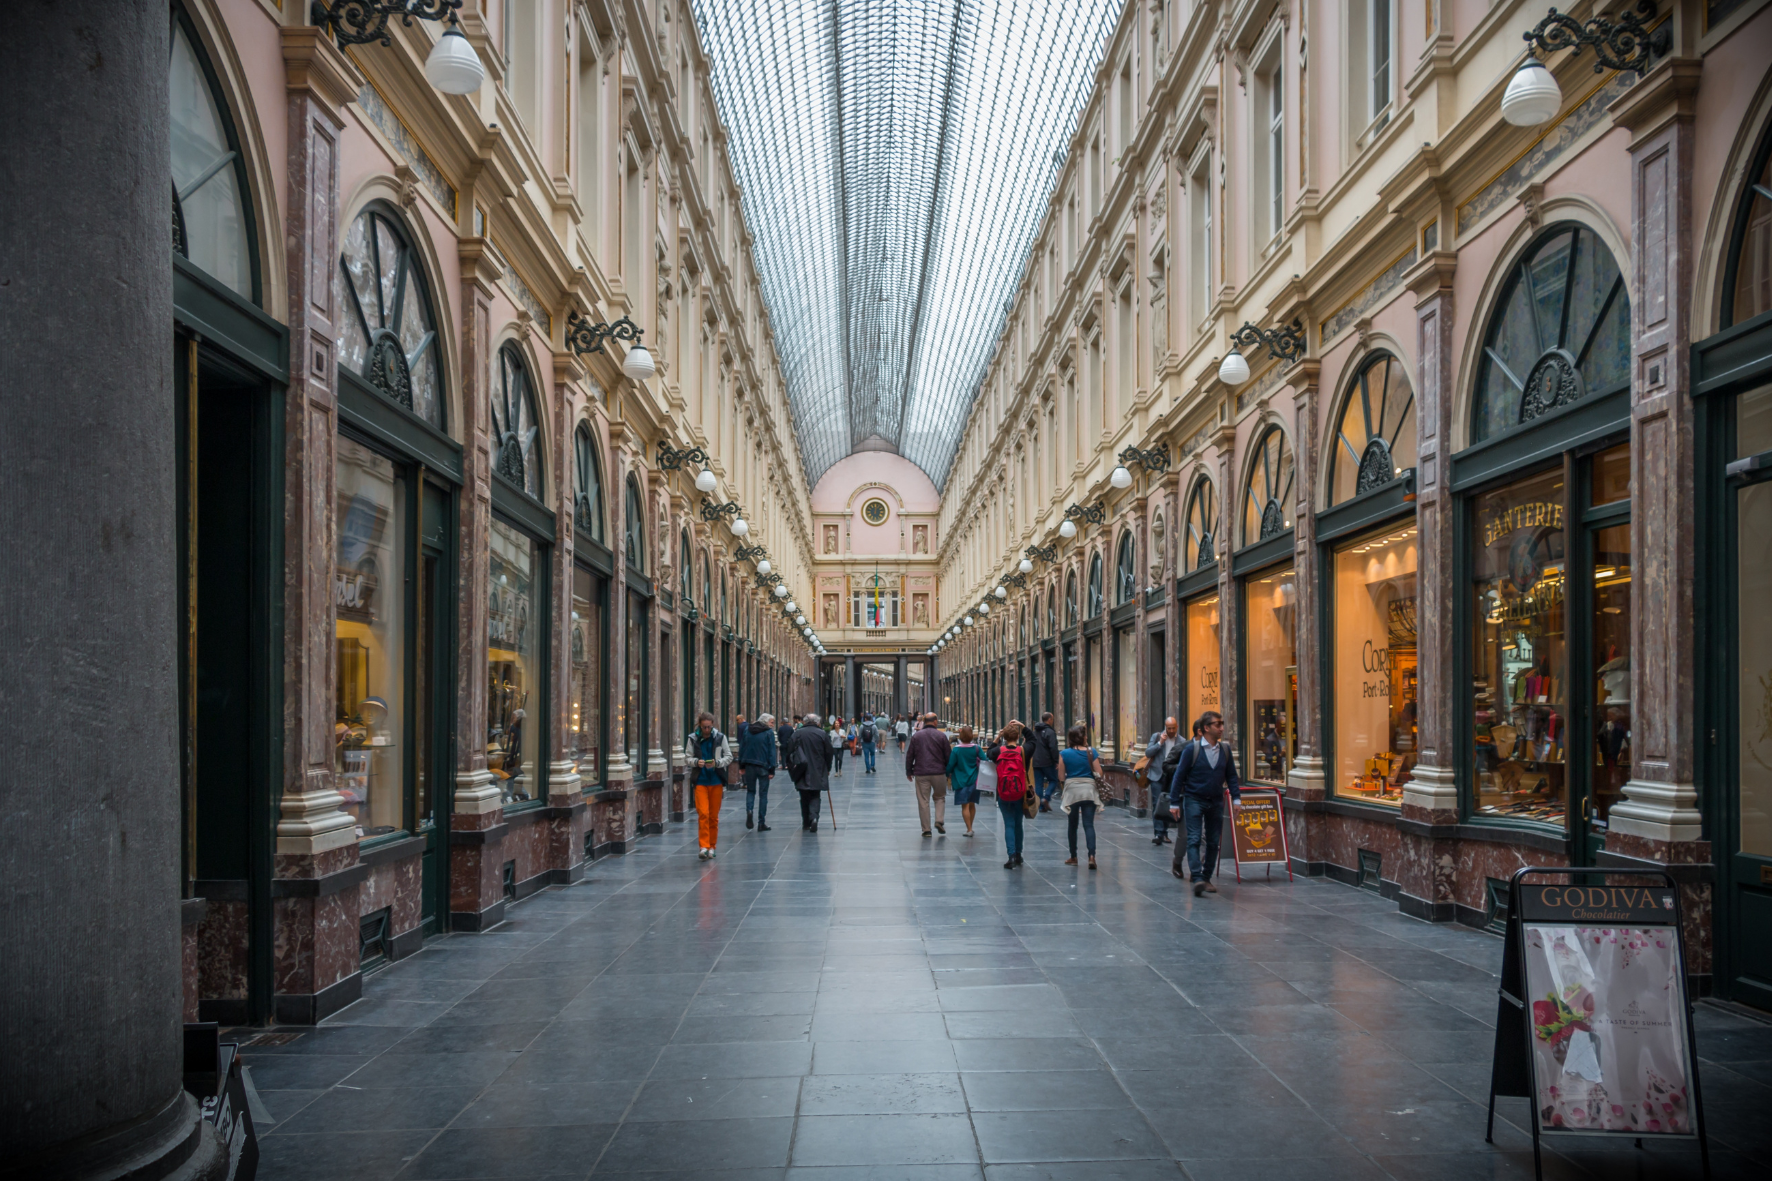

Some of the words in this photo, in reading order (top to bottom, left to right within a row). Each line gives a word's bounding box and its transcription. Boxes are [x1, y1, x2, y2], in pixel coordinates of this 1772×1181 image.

[1482, 502, 1564, 547] GANTERIE
[1541, 886, 1659, 909] GODIVA
[1571, 908, 1631, 920] Chocolatier
